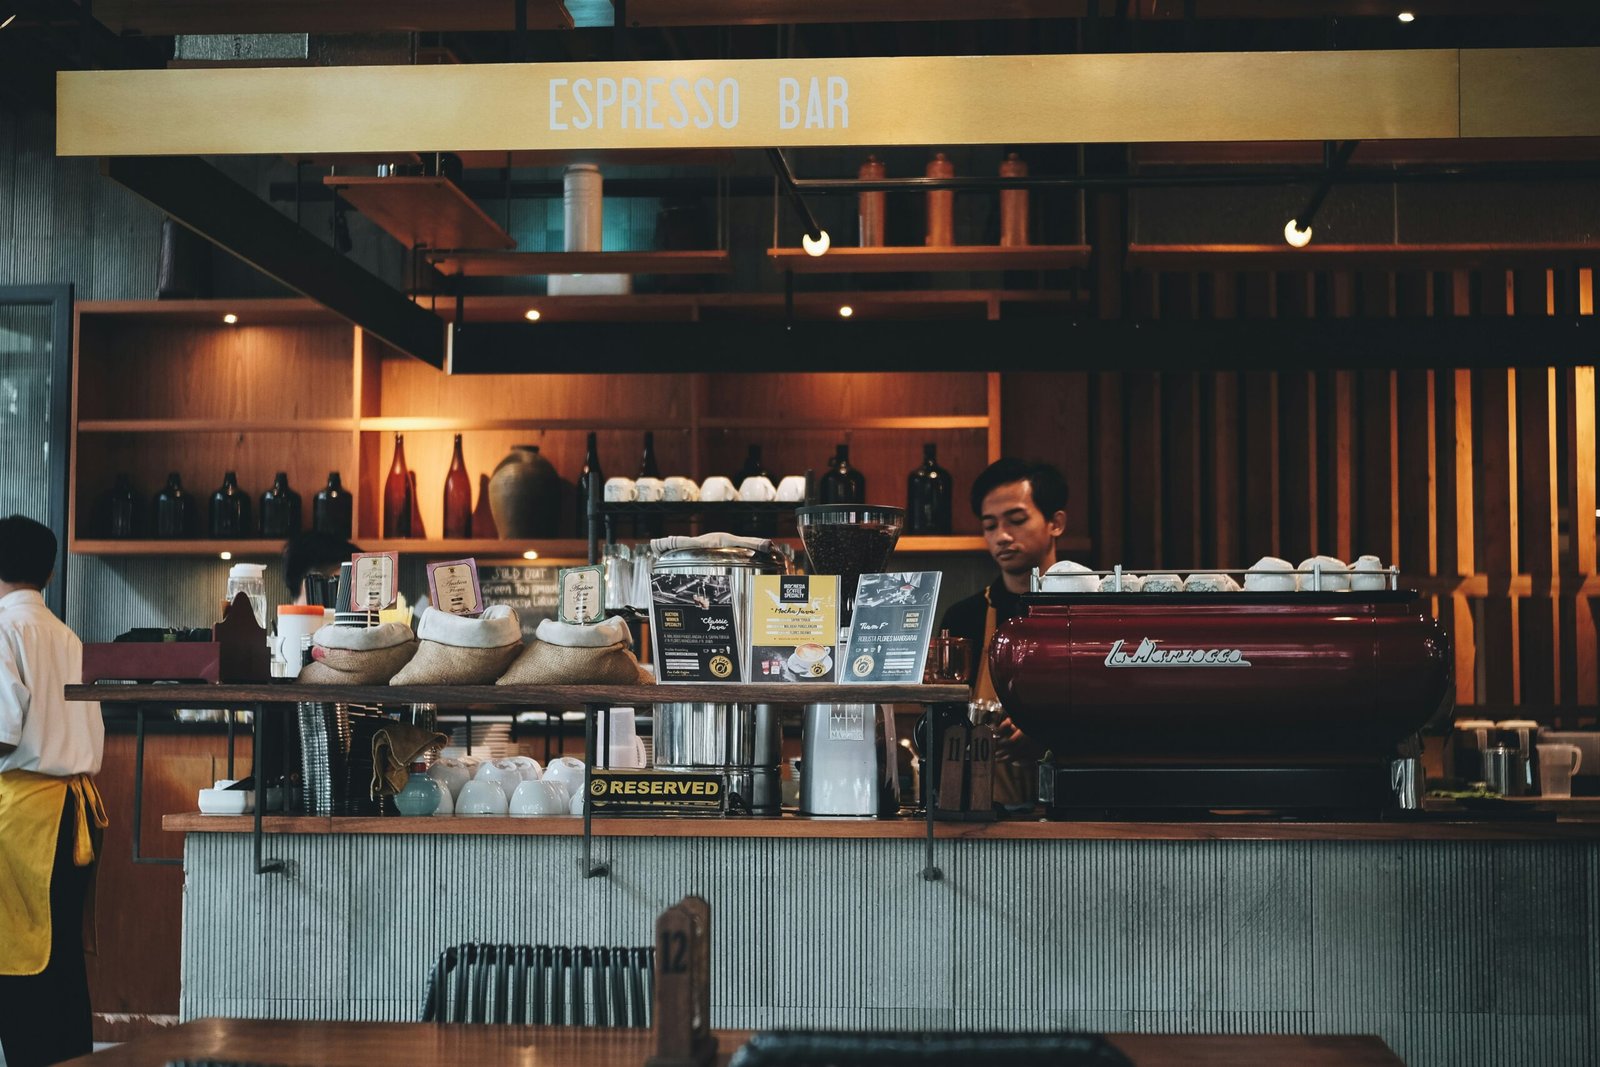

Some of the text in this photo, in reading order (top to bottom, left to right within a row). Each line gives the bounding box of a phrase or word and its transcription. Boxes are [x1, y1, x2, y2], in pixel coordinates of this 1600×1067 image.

[549, 76, 849, 131] ESPRESSO BAR
[482, 582, 512, 595] Green
[515, 581, 530, 596] Tea
[857, 634, 877, 642] ROBUSTA
[876, 634, 893, 642] FLORES
[1130, 637, 1243, 666] Marzocco
[609, 781, 719, 795] RESERVED
[661, 929, 688, 975] 12
